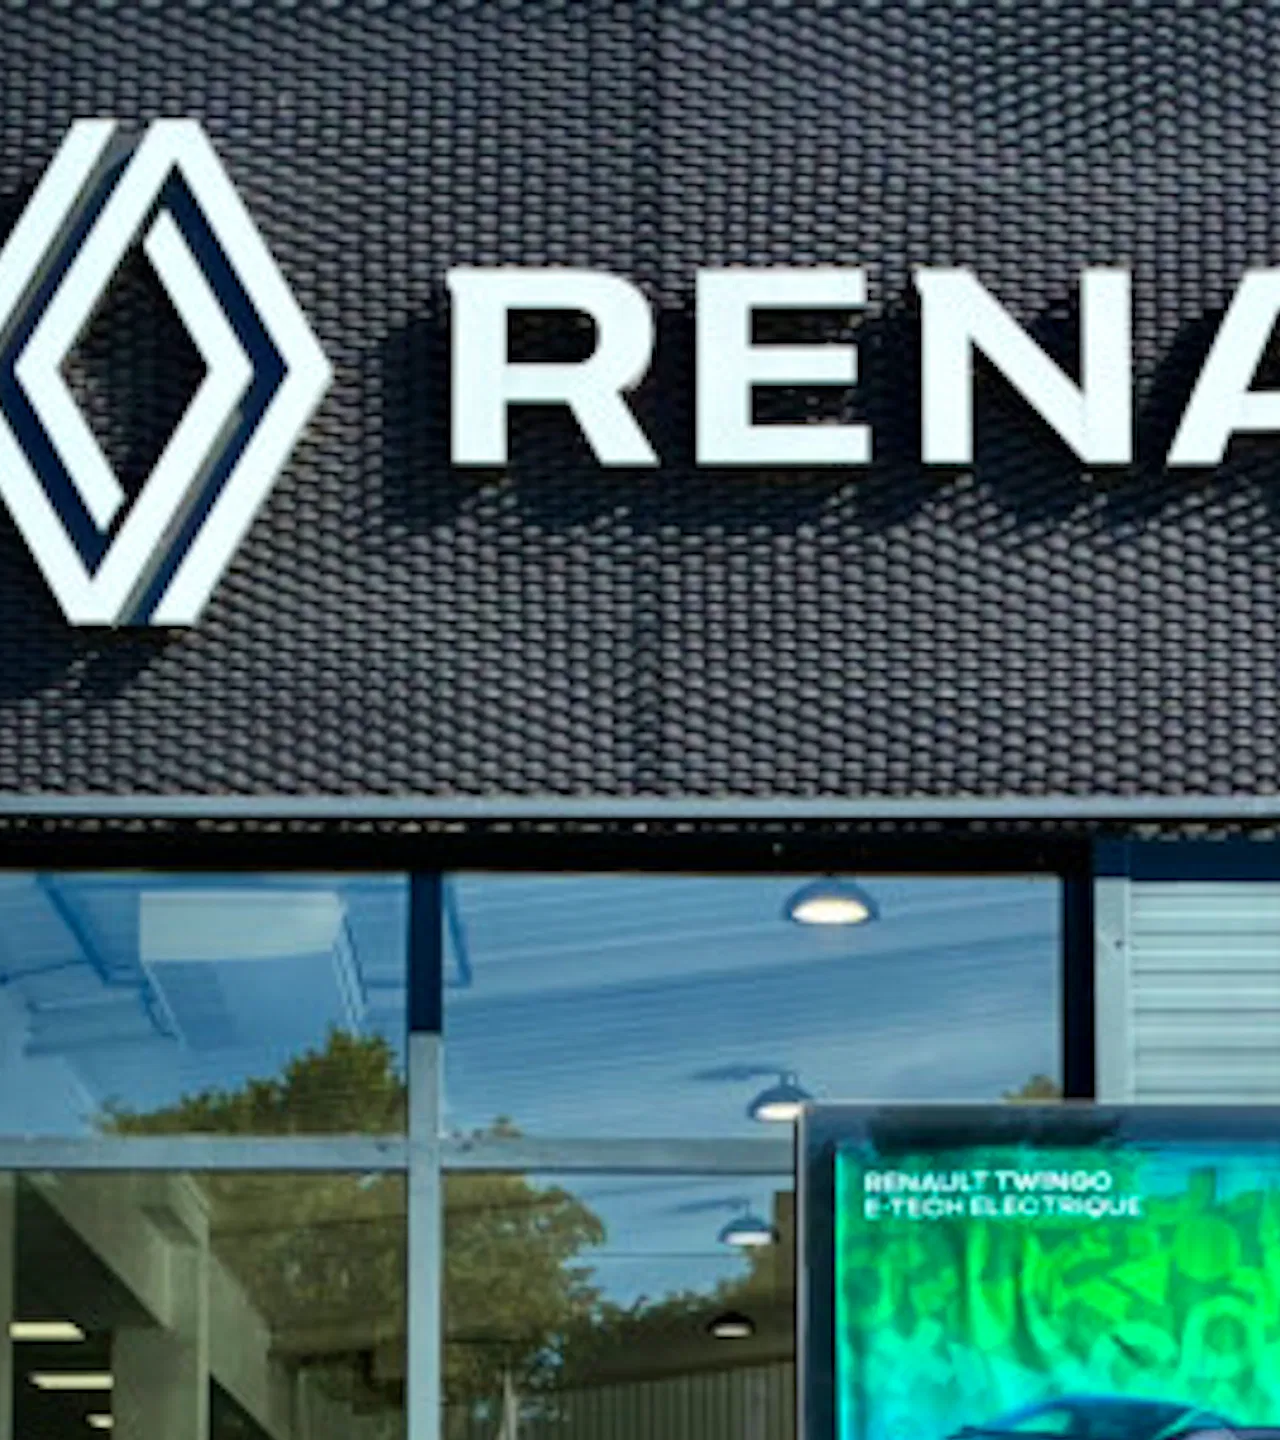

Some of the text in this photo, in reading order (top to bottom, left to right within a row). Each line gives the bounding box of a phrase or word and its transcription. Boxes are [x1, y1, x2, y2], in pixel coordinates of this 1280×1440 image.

[863, 1169, 1113, 1194] RENAULT TWINGO
[863, 1195, 966, 1220] E-TECH
